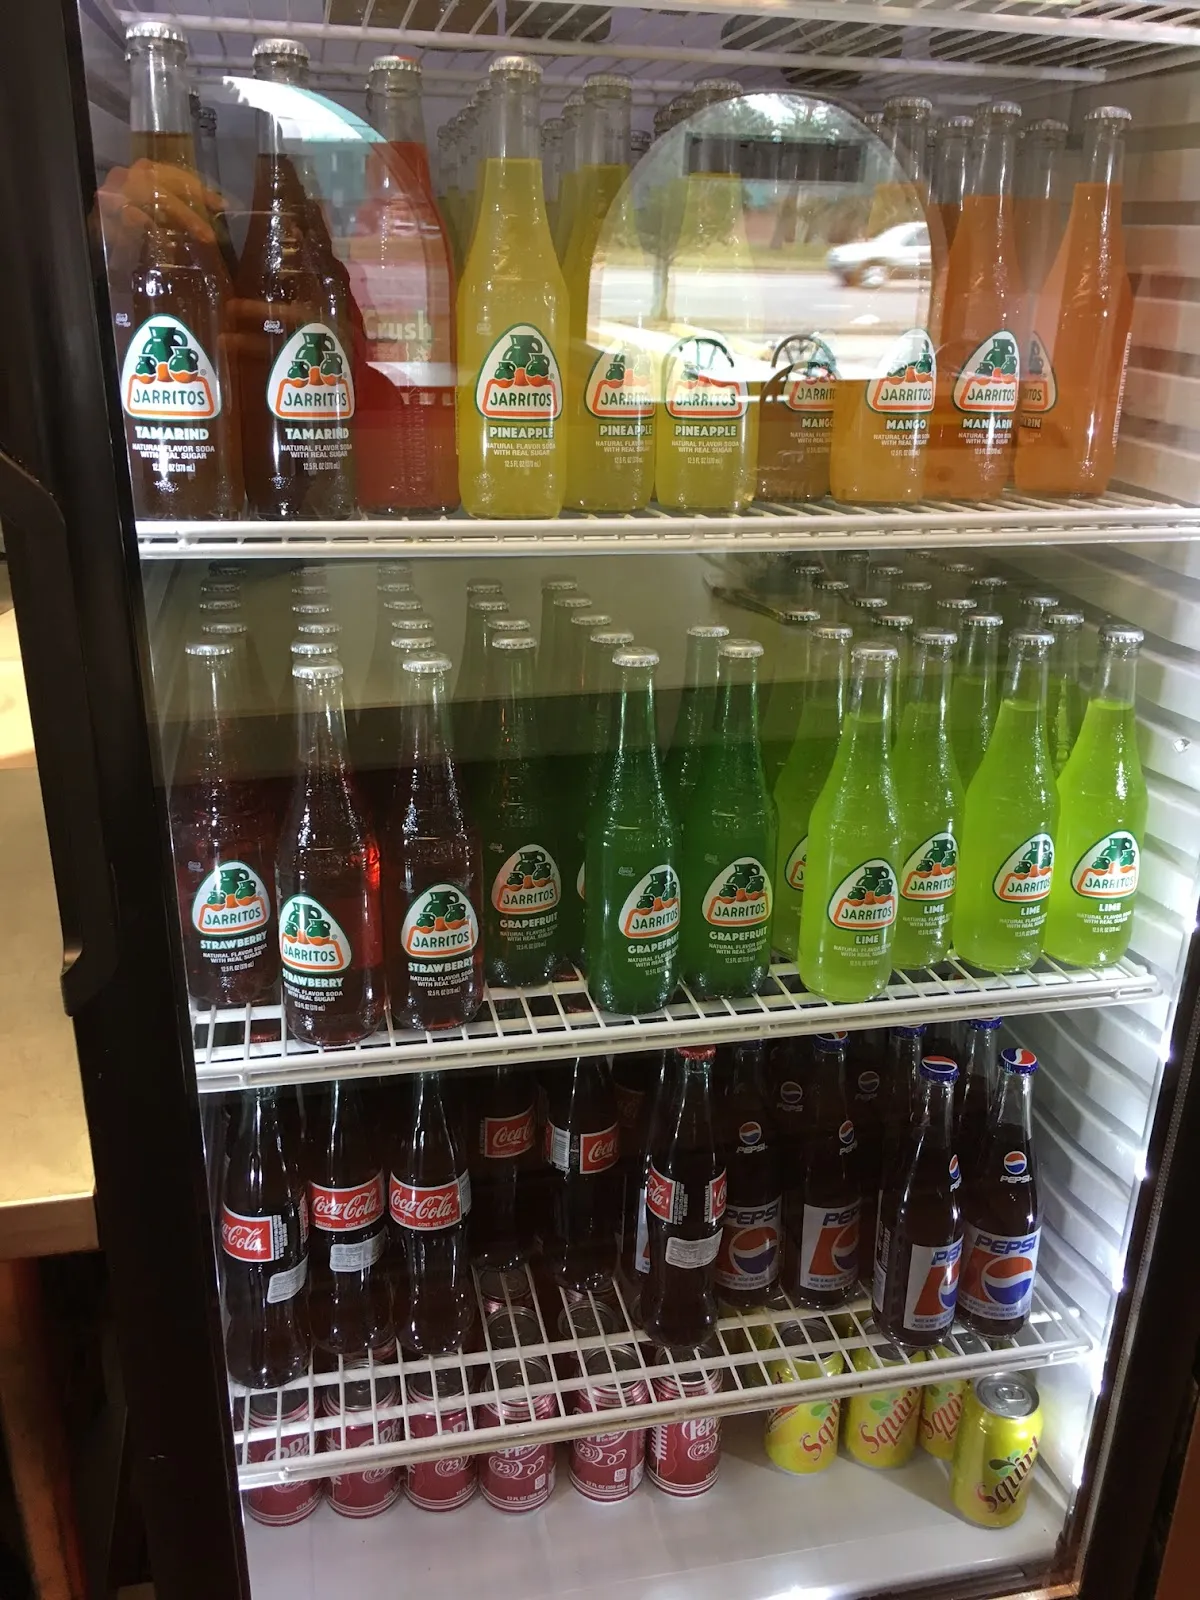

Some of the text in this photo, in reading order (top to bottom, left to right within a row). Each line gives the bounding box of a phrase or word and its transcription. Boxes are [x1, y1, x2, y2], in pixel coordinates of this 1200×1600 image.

[363, 310, 433, 341] Crush
[133, 388, 205, 406] JARRITOS
[284, 392, 347, 406] JARRITOS
[490, 392, 552, 407] JARRITOS
[676, 393, 736, 406] JARRITOS
[797, 388, 836, 401] JARRIT
[881, 388, 932, 401] JARRITOS
[967, 388, 1015, 401] JARRITOS
[600, 424, 653, 436] PINEAPPLE
[675, 425, 737, 436] PINEAPPLE
[886, 419, 927, 430] MANGO
[962, 418, 1013, 429] MANARIN
[134, 425, 209, 441] TAMARIND
[285, 427, 350, 440] TAMARIND
[489, 426, 554, 438] PINEAPPLE
[281, 444, 313, 452] NATURAL
[180, 452, 207, 460] SUGAR
[1085, 876, 1134, 889] JARRITOS
[503, 888, 554, 905] JARRITOS
[714, 902, 766, 918] JARRITOS
[841, 906, 892, 920] JARRITOS
[923, 903, 945, 915] LIME
[1020, 904, 1041, 916] LIME
[1098, 902, 1122, 912] LIME
[205, 906, 261, 925] JARRITOS
[500, 911, 558, 929] GRAPEFRUIT
[632, 907, 678, 930] JARRITOS
[200, 930, 268, 950] STRAWBERRY
[413, 931, 470, 948] JARRITOS
[709, 926, 768, 942] GRAPEFRUIT
[855, 934, 880, 945] LIME
[627, 931, 680, 954] GRAPEFRUIT
[230, 948, 254, 958] FLAVOR
[284, 943, 336, 962] JARRITOS
[407, 954, 475, 973] STRAWBERRY
[282, 967, 345, 988] STRAWBERRY
[437, 973, 461, 981] FLAVOR
[301, 989, 325, 997] FLAVOR
[735, 1142, 766, 1154] PEPSI
[839, 1140, 858, 1156] PEP
[1000, 1174, 1032, 1183] PEPSI
[313, 1188, 379, 1220] Coca-Cola
[391, 1189, 454, 1219] Coca-Cola
[726, 1203, 779, 1225] PEPS
[822, 1206, 860, 1227] PEP
[222, 1223, 267, 1252] a-Cola
[974, 1234, 1037, 1254] PEPSI
[931, 1242, 963, 1265] PEP
[860, 1385, 920, 1455] Squir
[920, 1391, 963, 1442] Squir
[579, 1443, 592, 1457] 23
[698, 1443, 710, 1455] 23
[446, 1460, 459, 1472] 23
[497, 1461, 511, 1474] 23
[976, 1435, 1039, 1513] Squirt
